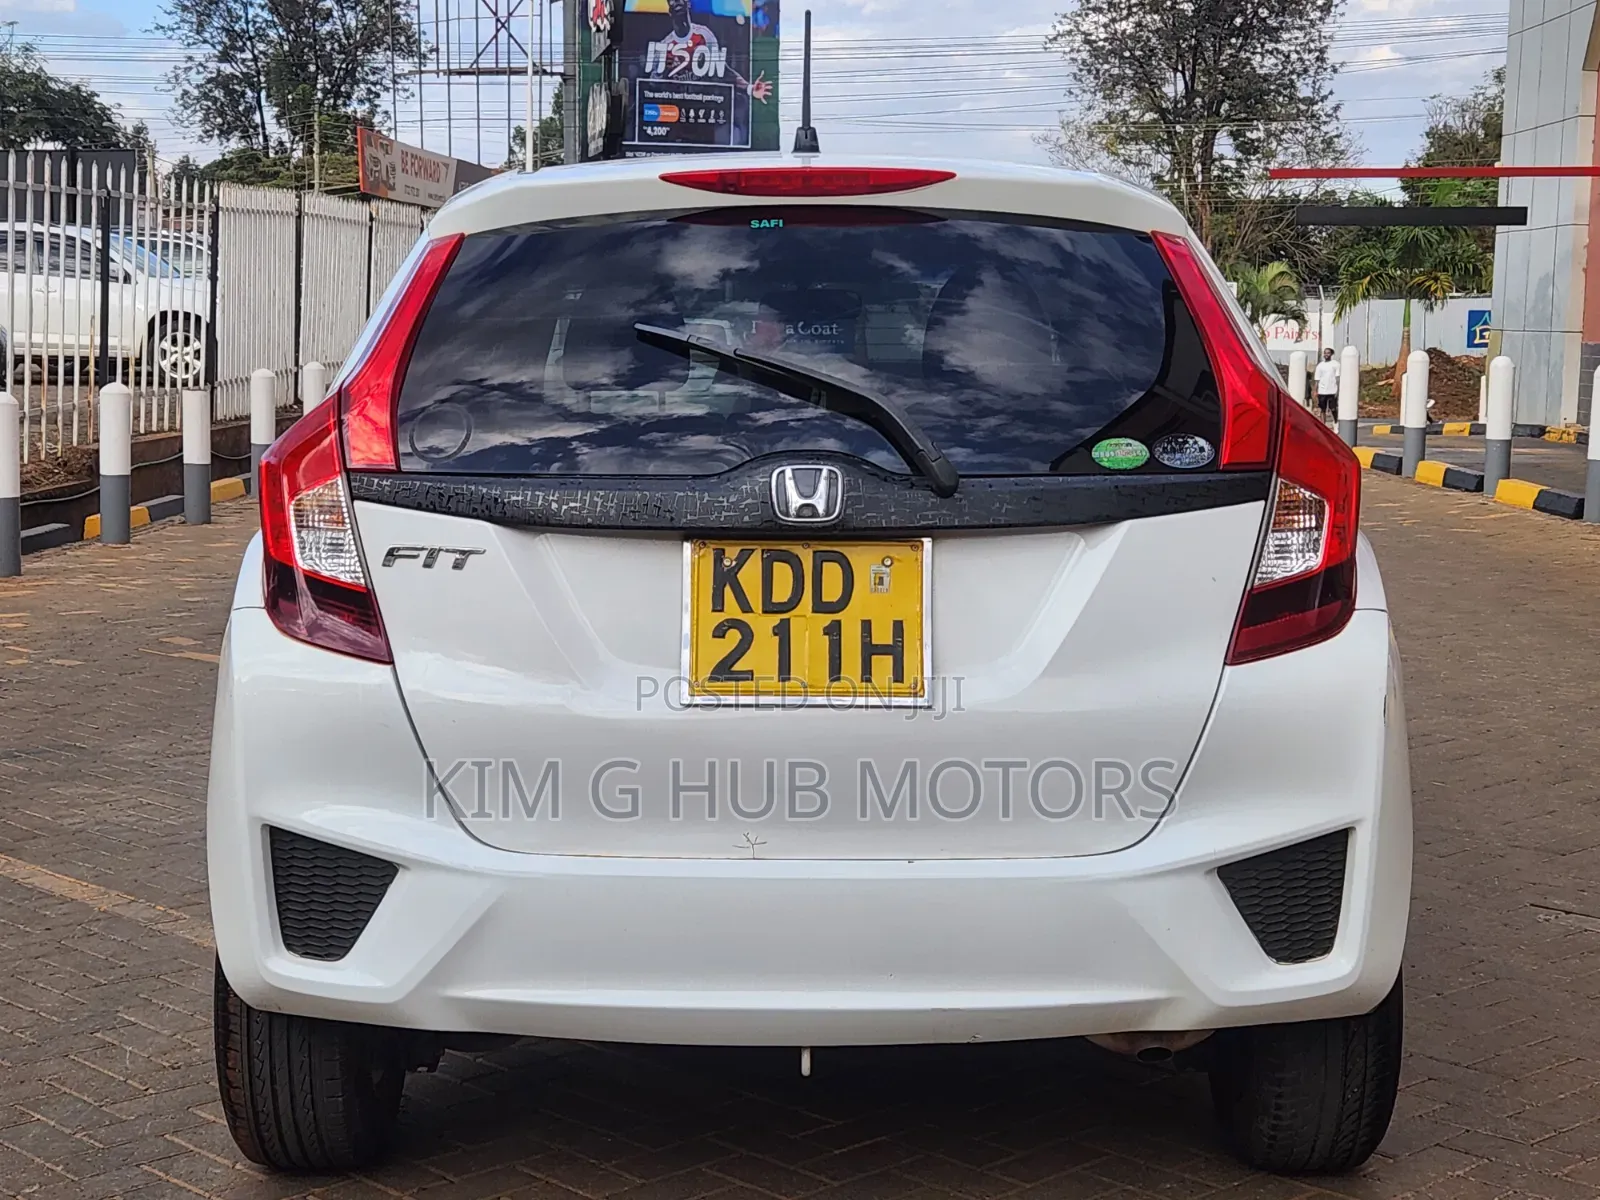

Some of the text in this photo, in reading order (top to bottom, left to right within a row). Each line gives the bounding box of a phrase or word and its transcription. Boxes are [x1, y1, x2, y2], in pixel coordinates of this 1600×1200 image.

[692, 45, 727, 78] ON
[644, 90, 724, 104] The world's best football package
[401, 149, 440, 183] BE FORWARD
[750, 219, 784, 229] SAFI
[381, 544, 487, 571] FIT
[711, 547, 855, 614] KDD
[707, 617, 904, 683] 211H
